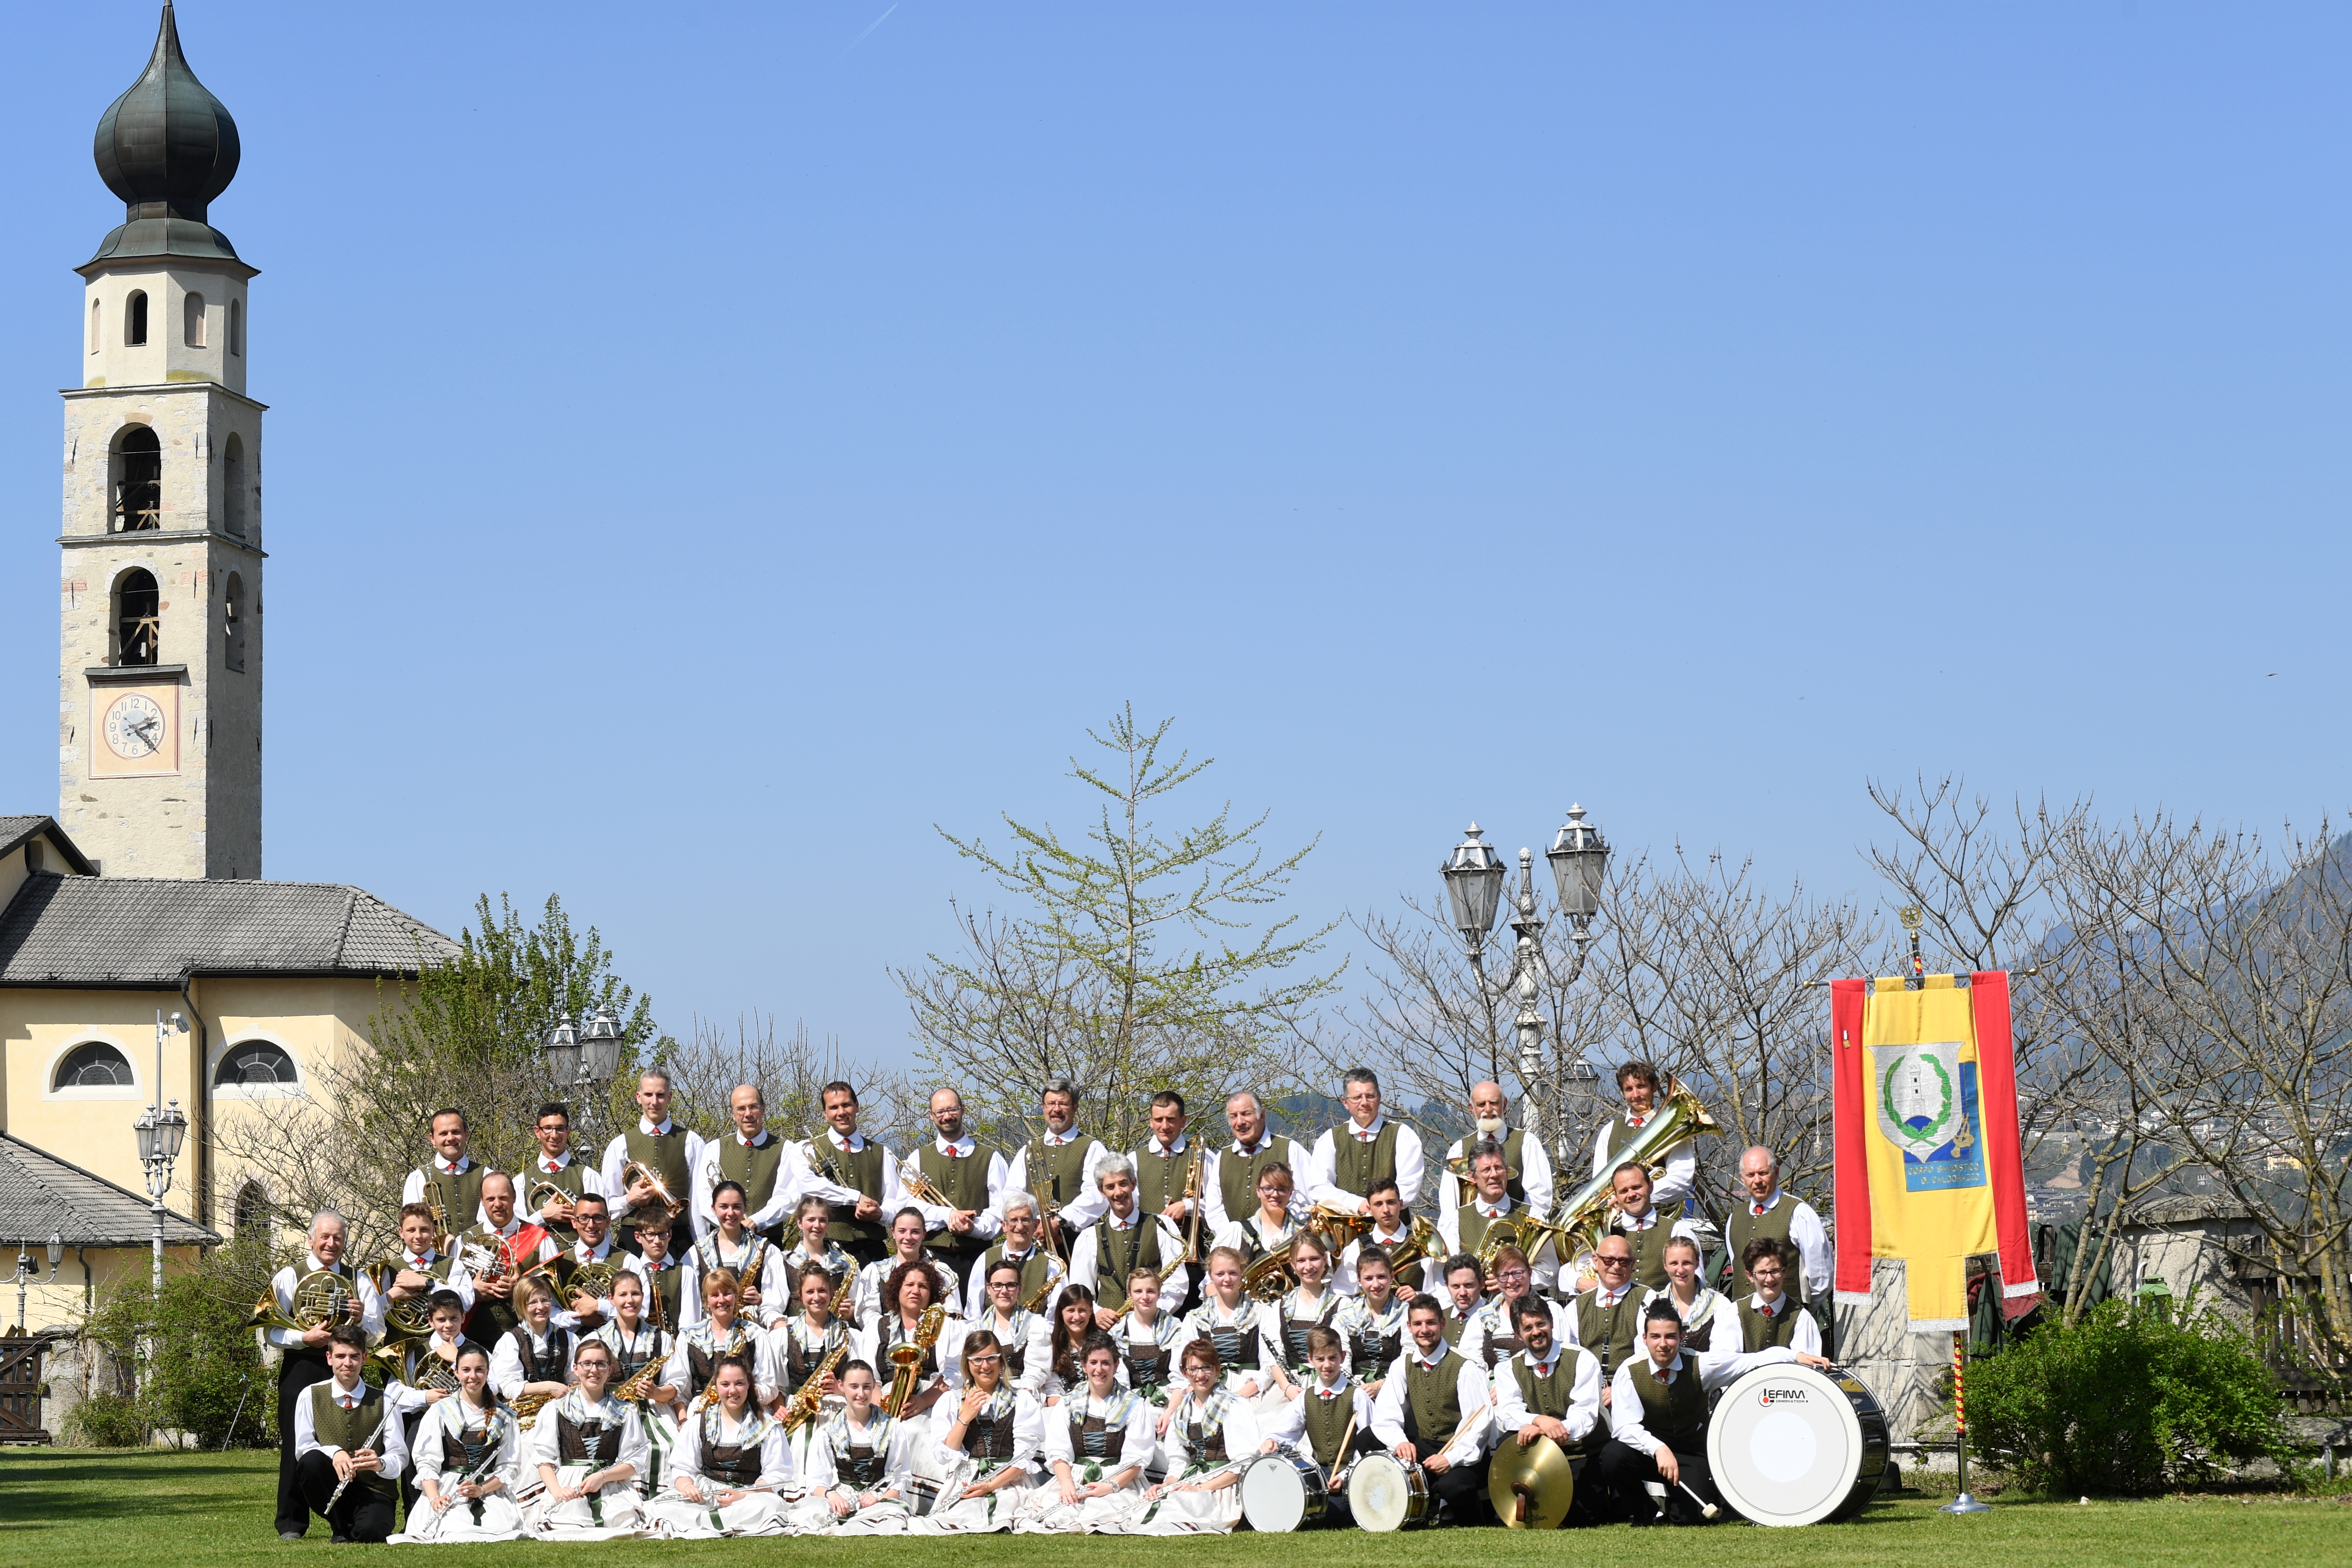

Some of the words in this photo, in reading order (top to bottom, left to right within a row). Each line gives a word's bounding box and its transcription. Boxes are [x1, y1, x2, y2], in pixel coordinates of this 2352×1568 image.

[121, 702, 127, 711] 11
[131, 698, 139, 708] 12
[145, 701, 147, 710] 1
[112, 711, 121, 720] 10
[151, 708, 158, 718] 2
[109, 722, 116, 732] 9
[153, 721, 160, 731] 3
[112, 734, 119, 744] 8
[151, 733, 158, 743] 4
[122, 742, 128, 752] 7
[132, 745, 138, 755] 6
[1908, 1166, 1933, 1175] CORPO
[1937, 1163, 1979, 1173] BANDISTICO
